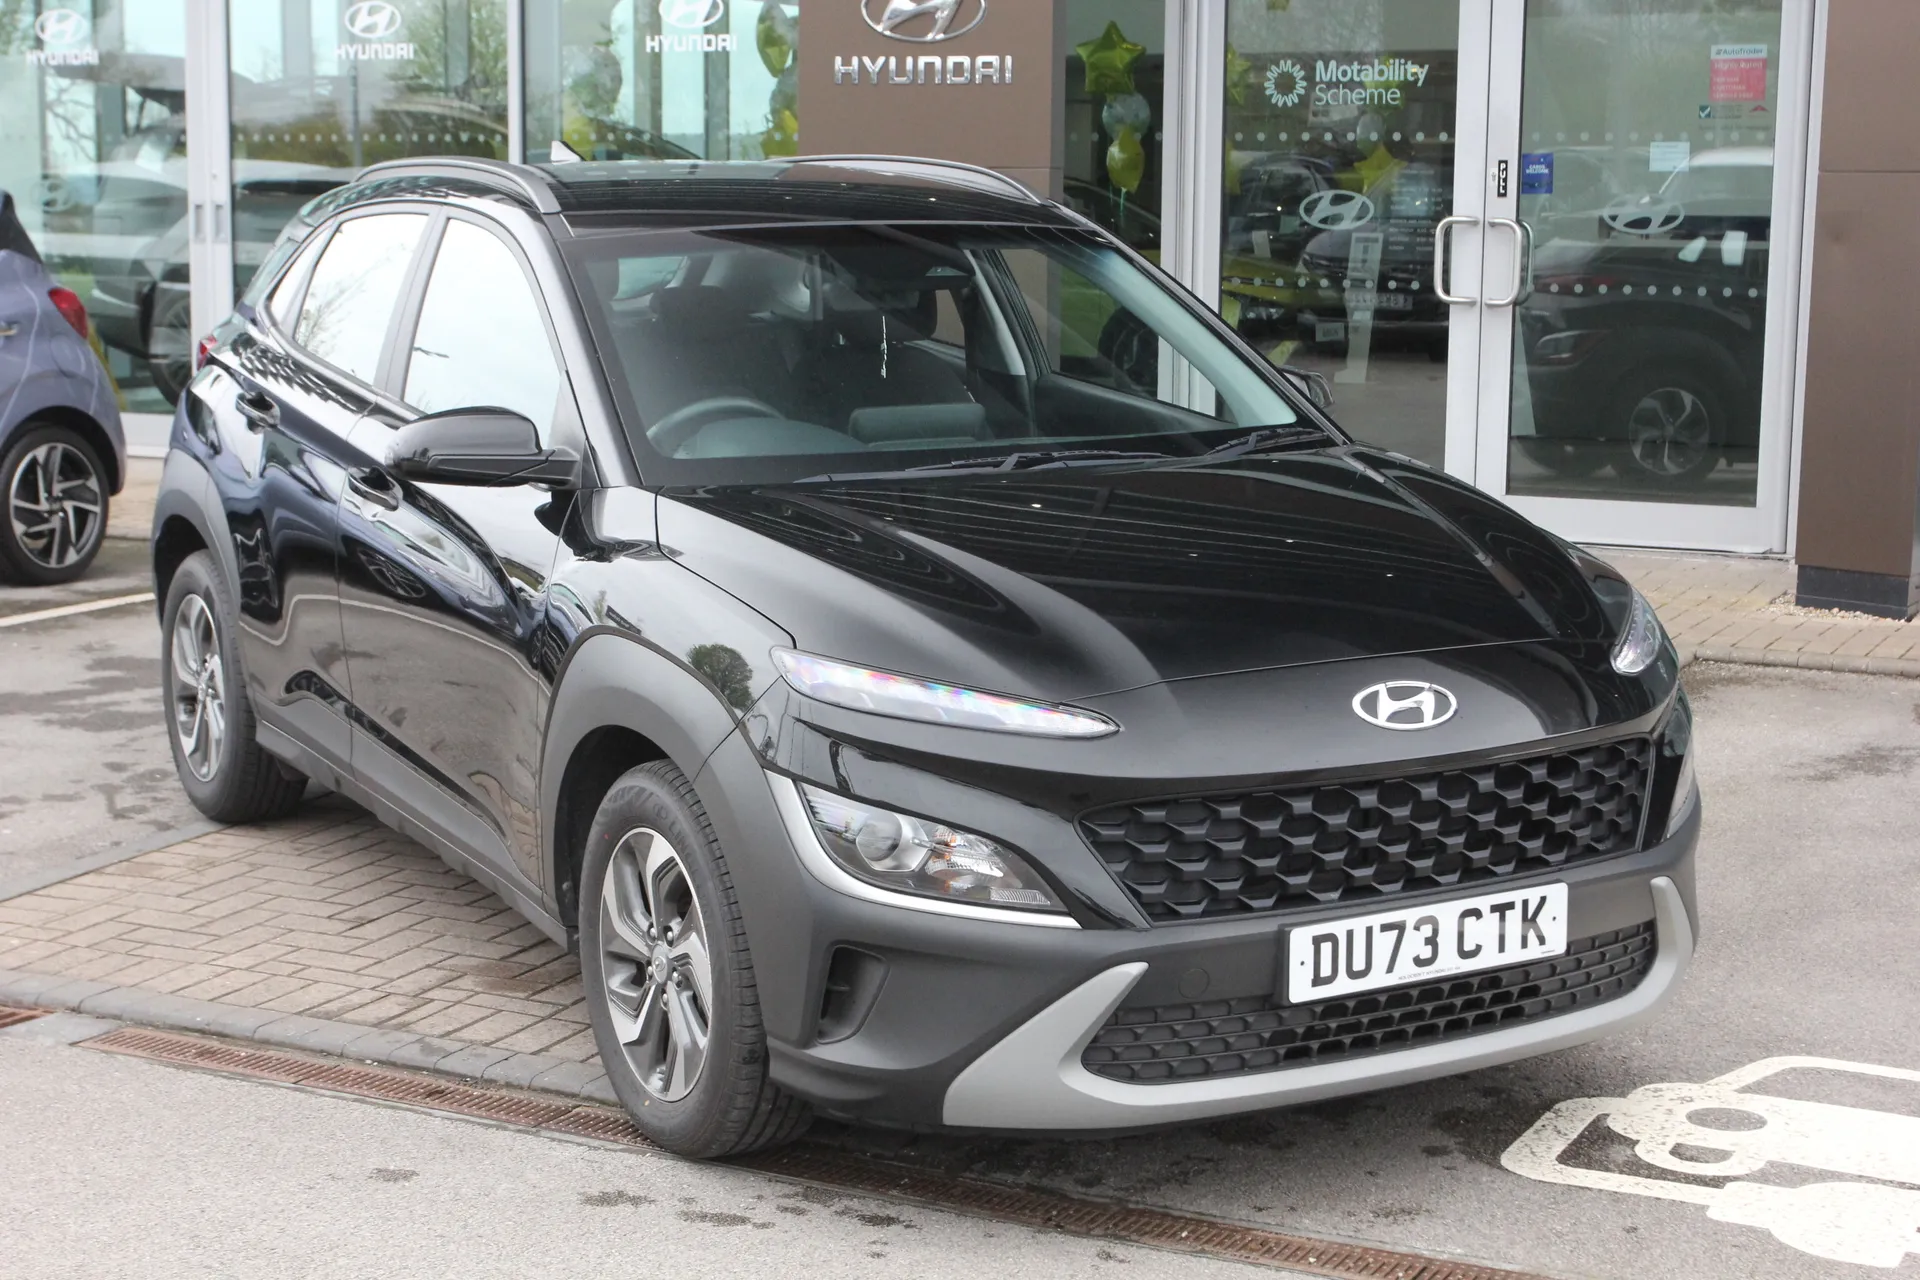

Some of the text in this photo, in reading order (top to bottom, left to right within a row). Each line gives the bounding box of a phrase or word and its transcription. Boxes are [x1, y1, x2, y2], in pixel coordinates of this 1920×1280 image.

[334, 43, 415, 60] HYUNDAI
[645, 34, 737, 52] HYUNDAI
[26, 49, 99, 66] HYUNDAI
[834, 55, 1013, 85] HYUNDAI
[1315, 59, 1429, 87] Motability
[1315, 84, 1400, 105] Scheme
[1311, 895, 1548, 988] DU73 CTK
